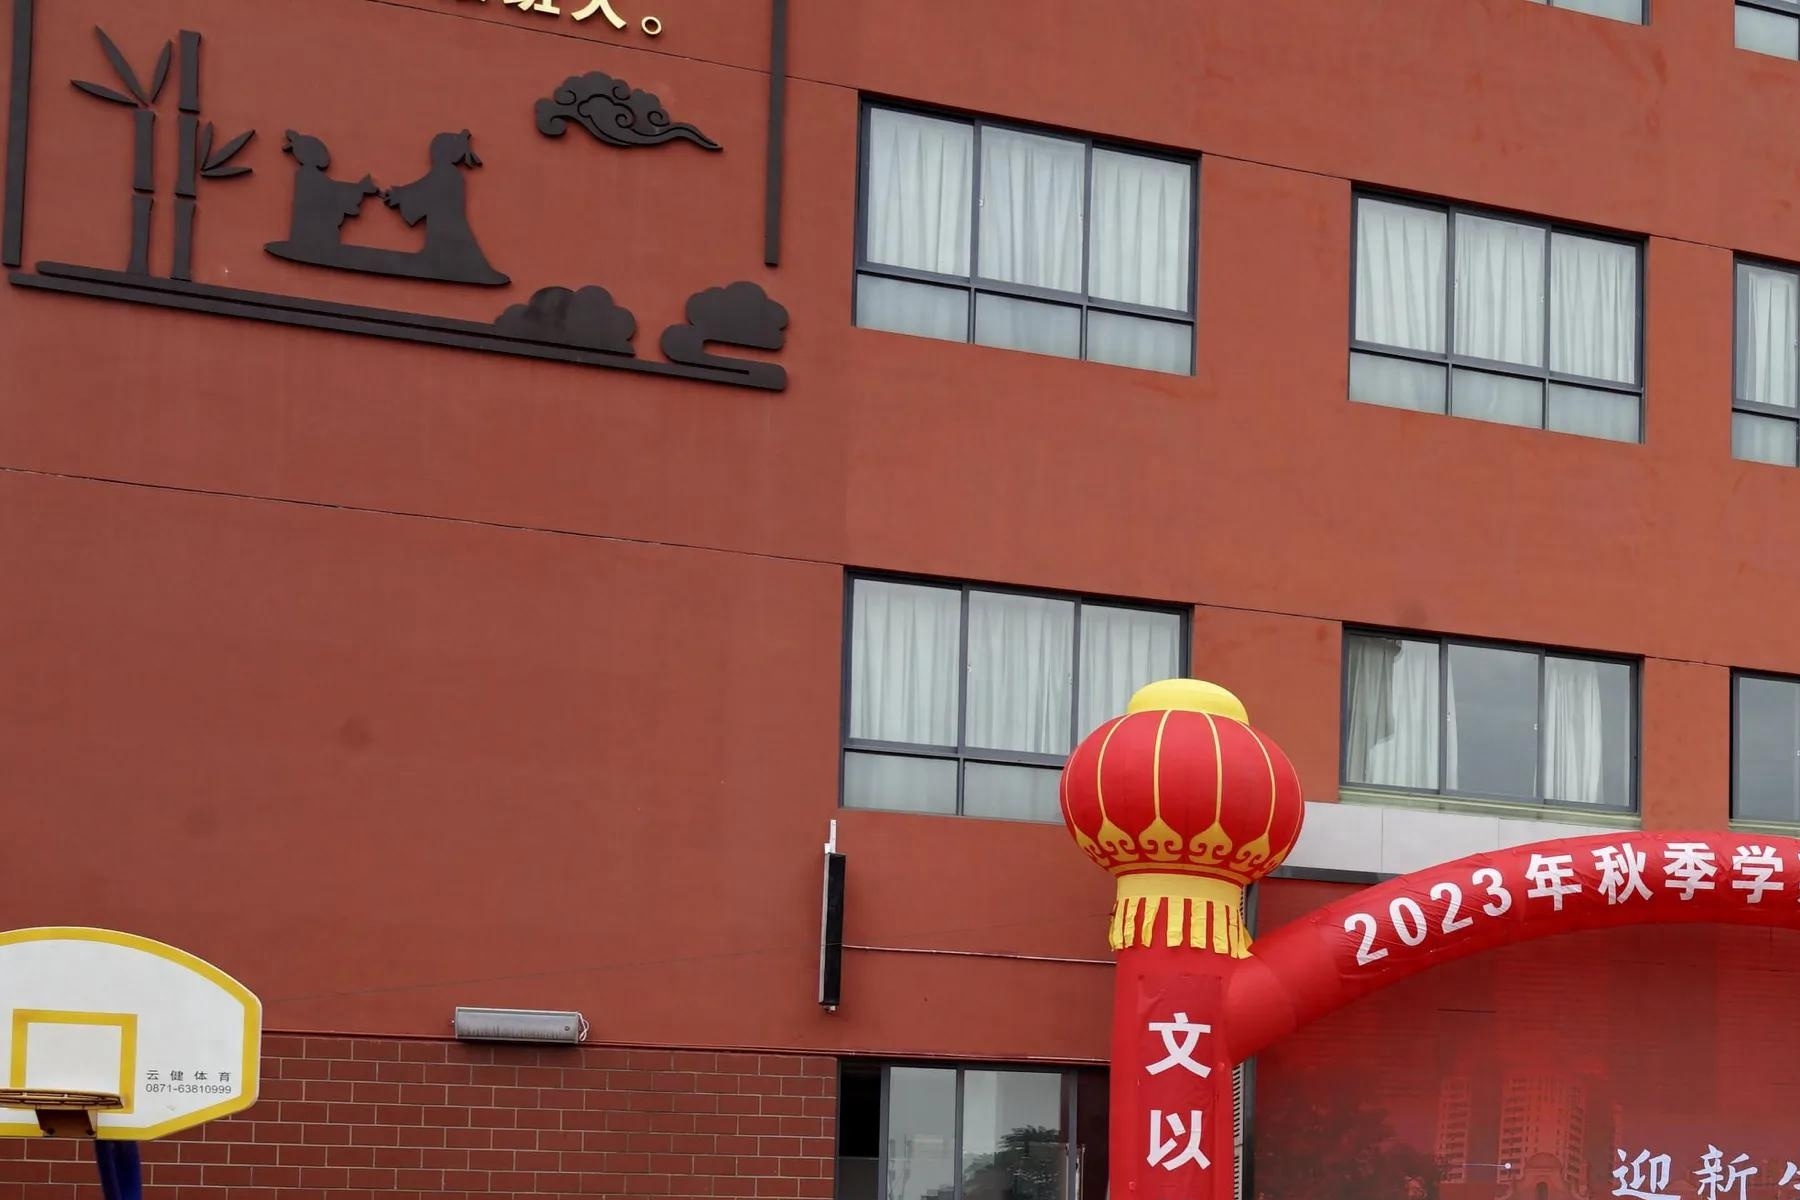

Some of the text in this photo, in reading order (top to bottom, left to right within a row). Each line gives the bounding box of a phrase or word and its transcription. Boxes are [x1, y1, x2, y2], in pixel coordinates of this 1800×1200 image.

[146, 1069, 232, 1082] 云健体育
[145, 1083, 232, 1094] 0871-63810999
